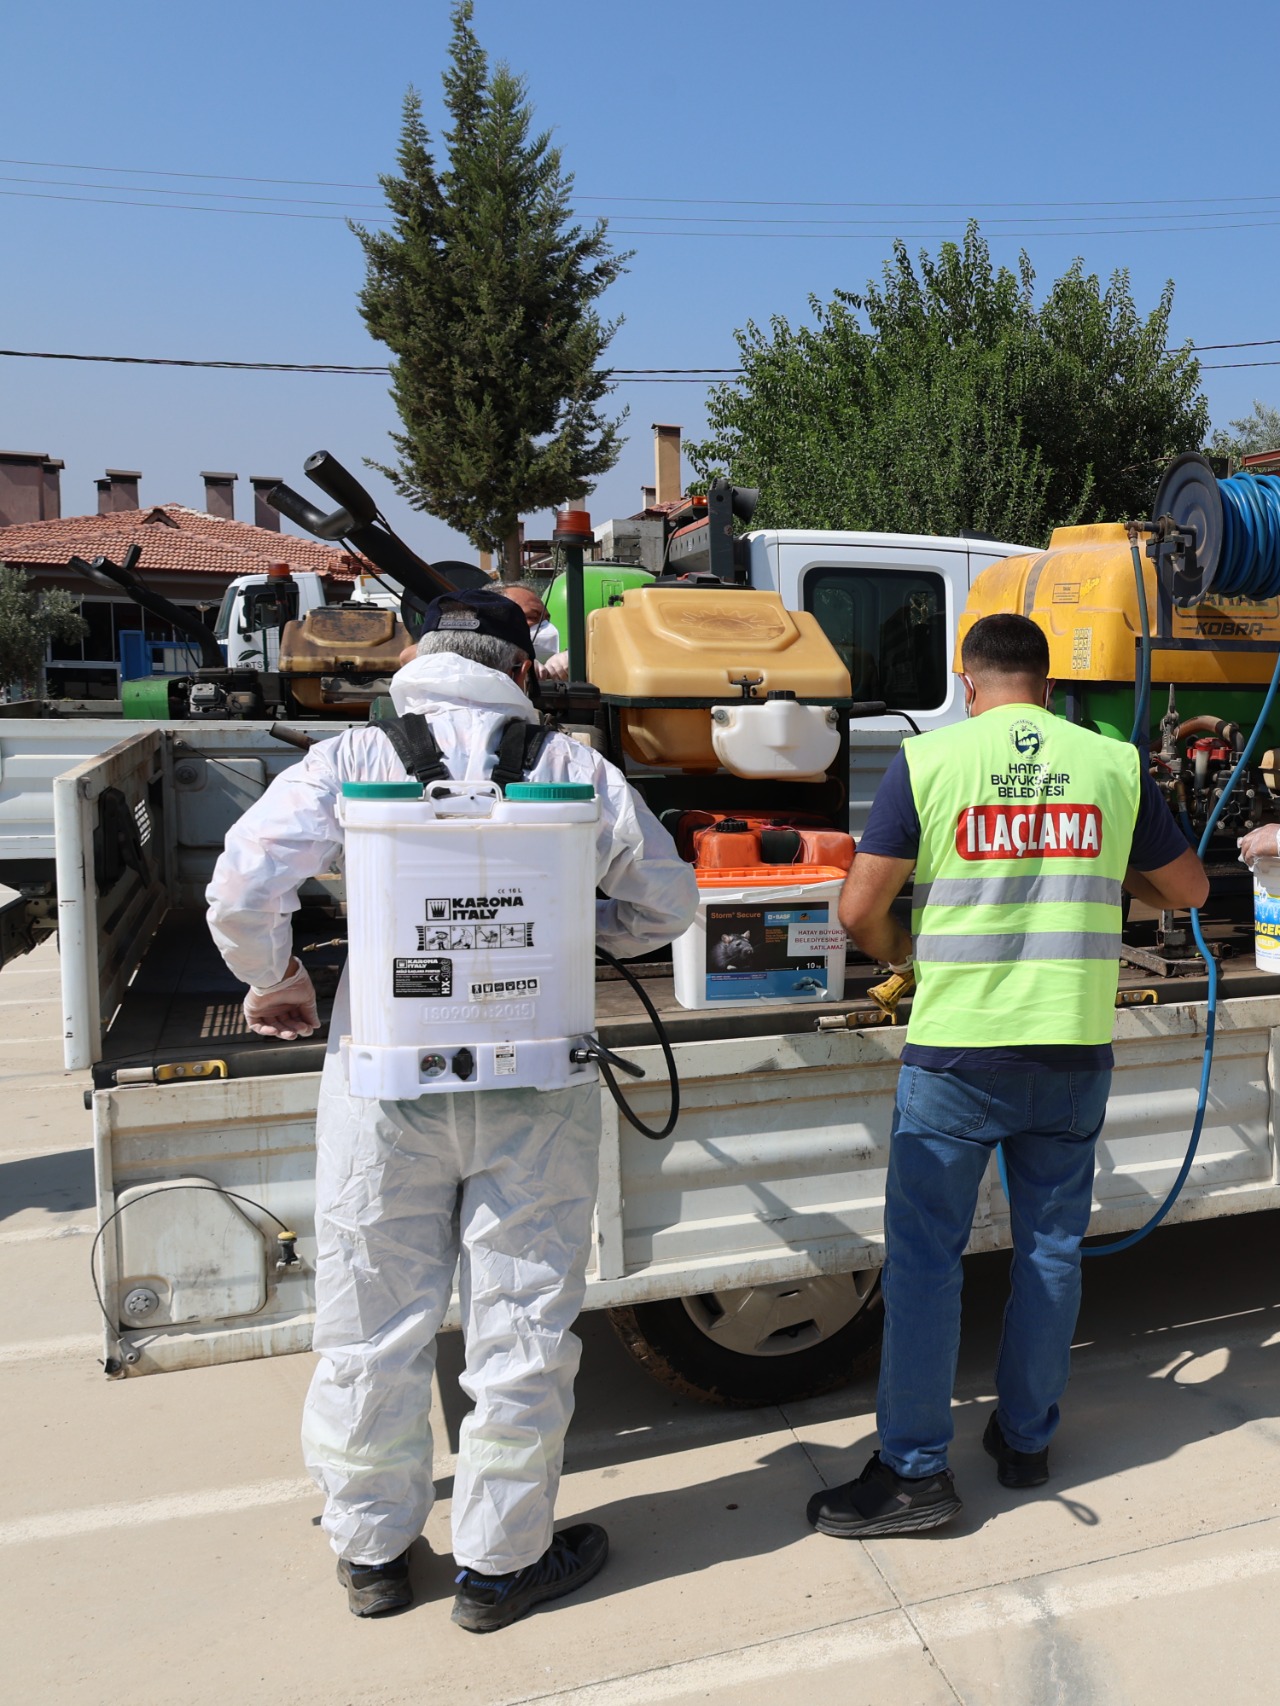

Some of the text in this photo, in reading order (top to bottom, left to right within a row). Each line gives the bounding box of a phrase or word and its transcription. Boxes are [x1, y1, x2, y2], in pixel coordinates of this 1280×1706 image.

[1195, 622, 1263, 636] KOBRA
[998, 785, 1065, 798] BELEDİYESİ
[966, 808, 1099, 857] İLAÇLAMA
[452, 896, 524, 908] KARONA
[452, 909, 499, 921] ITALY
[736, 911, 762, 919] Secure
